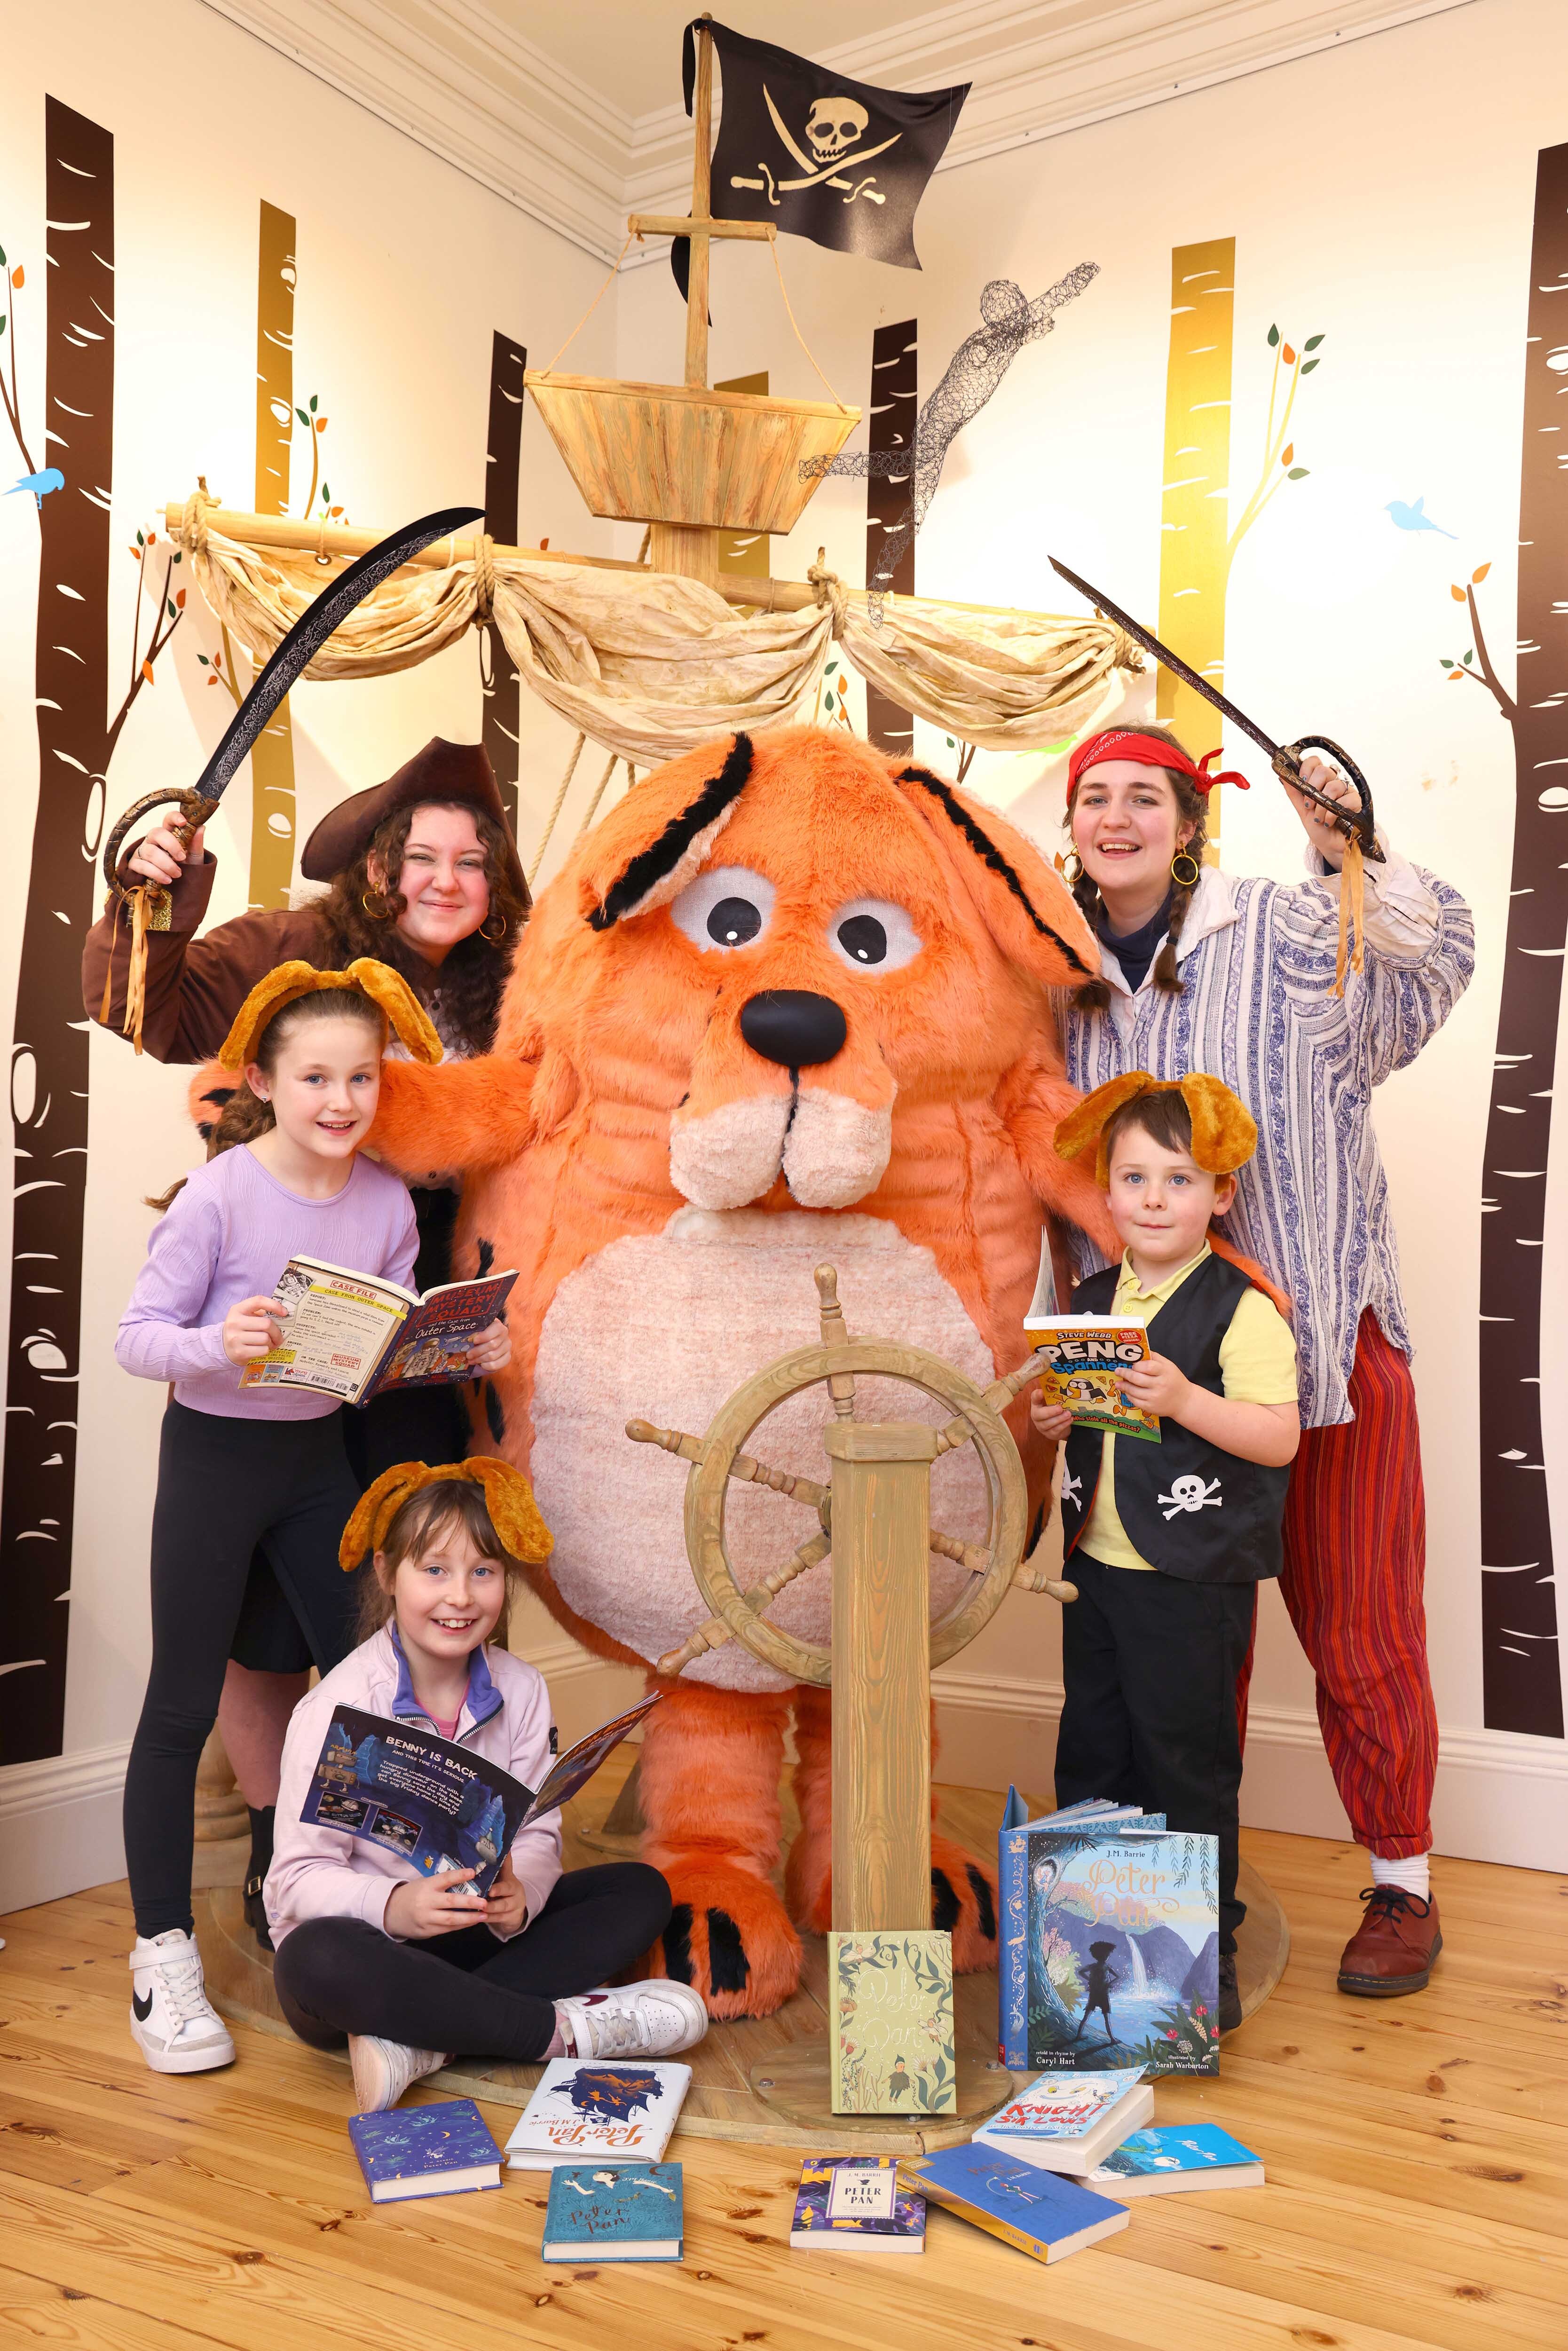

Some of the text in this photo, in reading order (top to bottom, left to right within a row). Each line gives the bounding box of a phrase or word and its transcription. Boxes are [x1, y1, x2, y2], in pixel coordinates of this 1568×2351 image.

[333, 1282, 375, 1298] CASE FILE
[433, 1285, 497, 1304] MUSEUM
[357, 1297, 375, 1306] OUTER
[377, 1303, 394, 1313] SPACE
[427, 1305, 482, 1321] SQUAD
[428, 1293, 491, 1314] MYSTERY
[415, 1322, 476, 1339] Outer Space
[1037, 1341, 1142, 1364] PENG
[1119, 1422, 1140, 1433] pizzas?
[386, 1736, 478, 1780] BENNY IS BACK
[379, 1764, 401, 1775] hungry
[402, 1772, 428, 1784] dinosaur
[383, 1760, 408, 1771] Trapped
[409, 1770, 446, 1788] underground
[447, 1787, 459, 1796] with
[443, 1769, 465, 1783] SERIOUS.
[389, 1776, 416, 1788] everyone
[417, 1786, 432, 1796] home
[439, 1797, 451, 1807] time
[393, 1773, 411, 1783] Benny
[437, 1791, 448, 1801] day
[400, 1785, 420, 1797] Friday
[421, 1794, 438, 1805] dance
[438, 1803, 457, 1815] party?
[1081, 1859, 1166, 1896] Peter
[1083, 1891, 1180, 1927] Pan
[858, 1967, 926, 2012] Peter
[862, 2018, 923, 2061] Pan
[1036, 2057, 1075, 2066] Caryl Hart
[1006, 2103, 1111, 2116] KNIGHT
[995, 2115, 1091, 2125] SIR LOUIS
[547, 2124, 644, 2147] Peter Pan
[1175, 2140, 1204, 2153] Peter
[1196, 2152, 1218, 2161] Pan
[902, 2174, 929, 2193] Peter Pan
[566, 2205, 629, 2225] Peter
[580, 2217, 630, 2234] Pan
